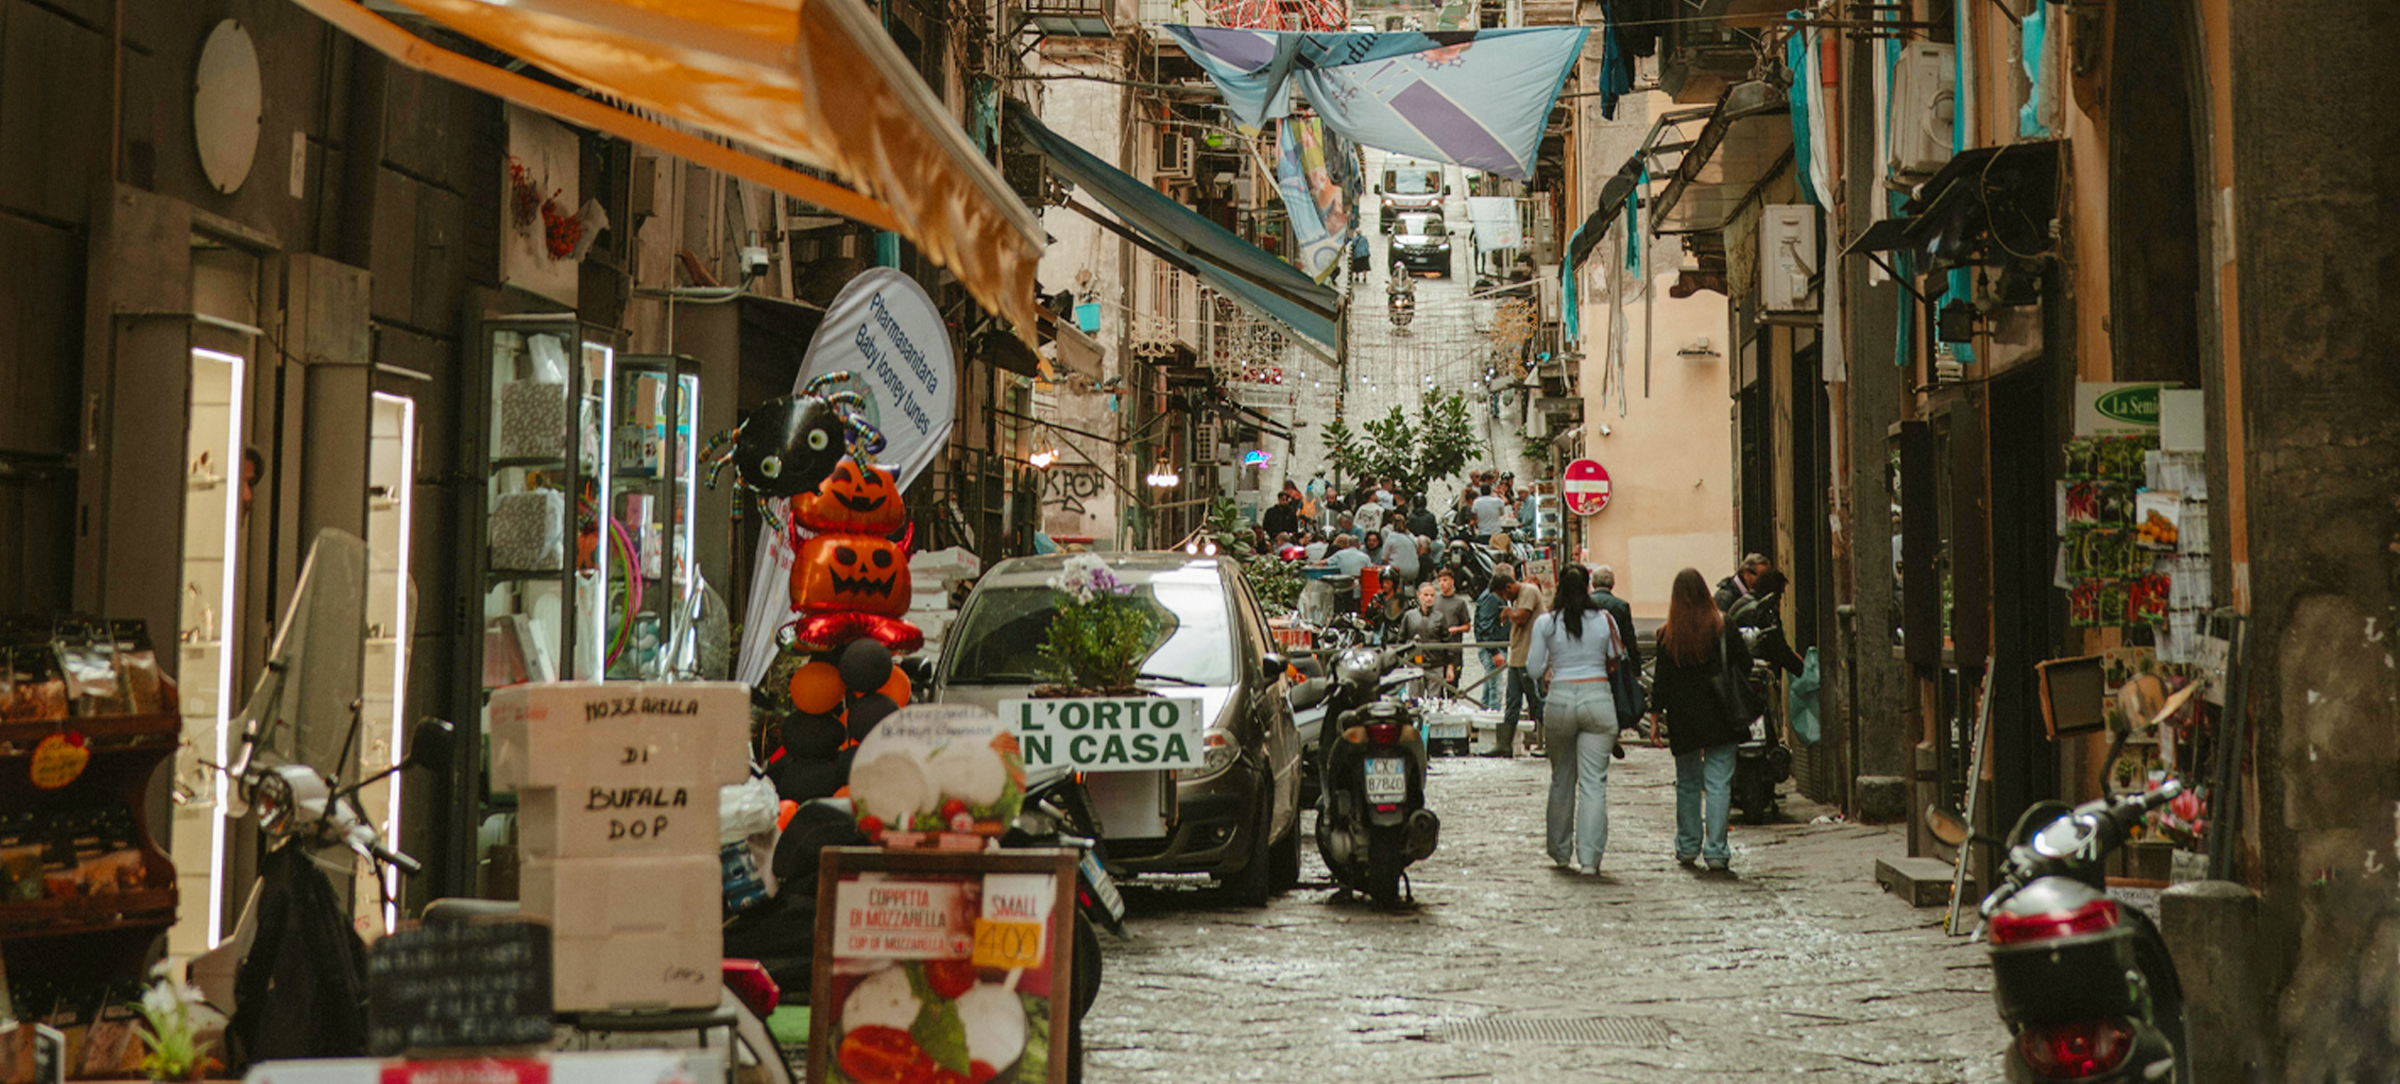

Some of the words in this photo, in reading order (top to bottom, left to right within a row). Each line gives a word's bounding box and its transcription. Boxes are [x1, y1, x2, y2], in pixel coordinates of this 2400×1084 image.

[870, 291, 938, 395] Pharmasanitaria
[855, 322, 880, 370] Baby
[876, 352, 906, 407] looney
[904, 390, 931, 436] tunes
[2113, 396, 2128, 414] La
[2130, 396, 2160, 415] Semi
[1021, 700, 1180, 731] L'ORTO
[620, 746, 648, 765] DI
[1016, 735, 1052, 765] N
[1069, 733, 1190, 764] CASA
[585, 786, 688, 810] BUFALA
[609, 815, 668, 839] DOP
[869, 887, 930, 907] COPPETTA
[991, 894, 1036, 917] SMALL
[849, 908, 863, 929] DI
[866, 909, 946, 929] MOZZARELLA
